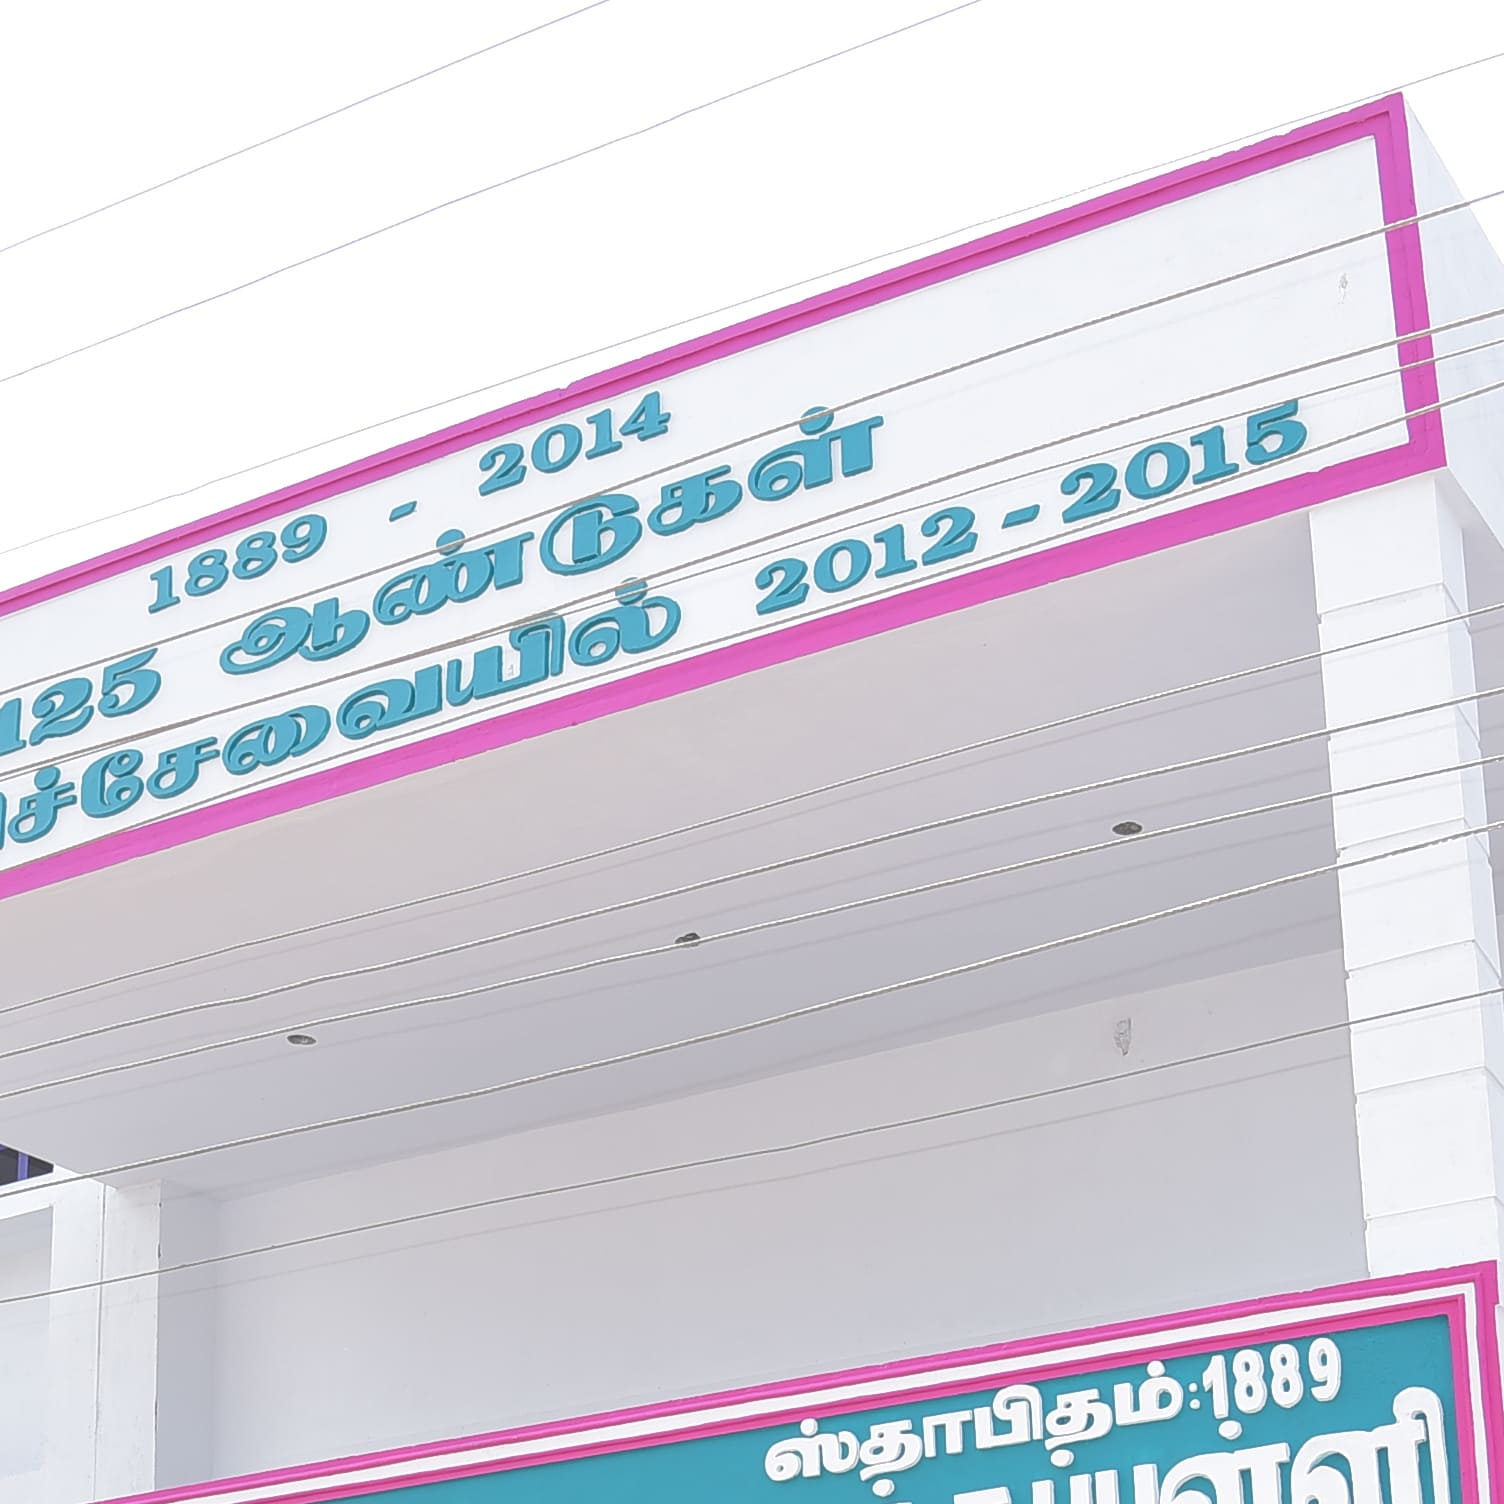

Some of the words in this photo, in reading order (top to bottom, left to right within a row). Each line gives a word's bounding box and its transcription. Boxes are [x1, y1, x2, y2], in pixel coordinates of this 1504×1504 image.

[148, 513, 328, 614] 1889
[477, 390, 672, 495] 2014
[218, 406, 885, 675] ஆண்டுகள்
[754, 504, 980, 617] 2012
[1059, 398, 1309, 525] 2015
